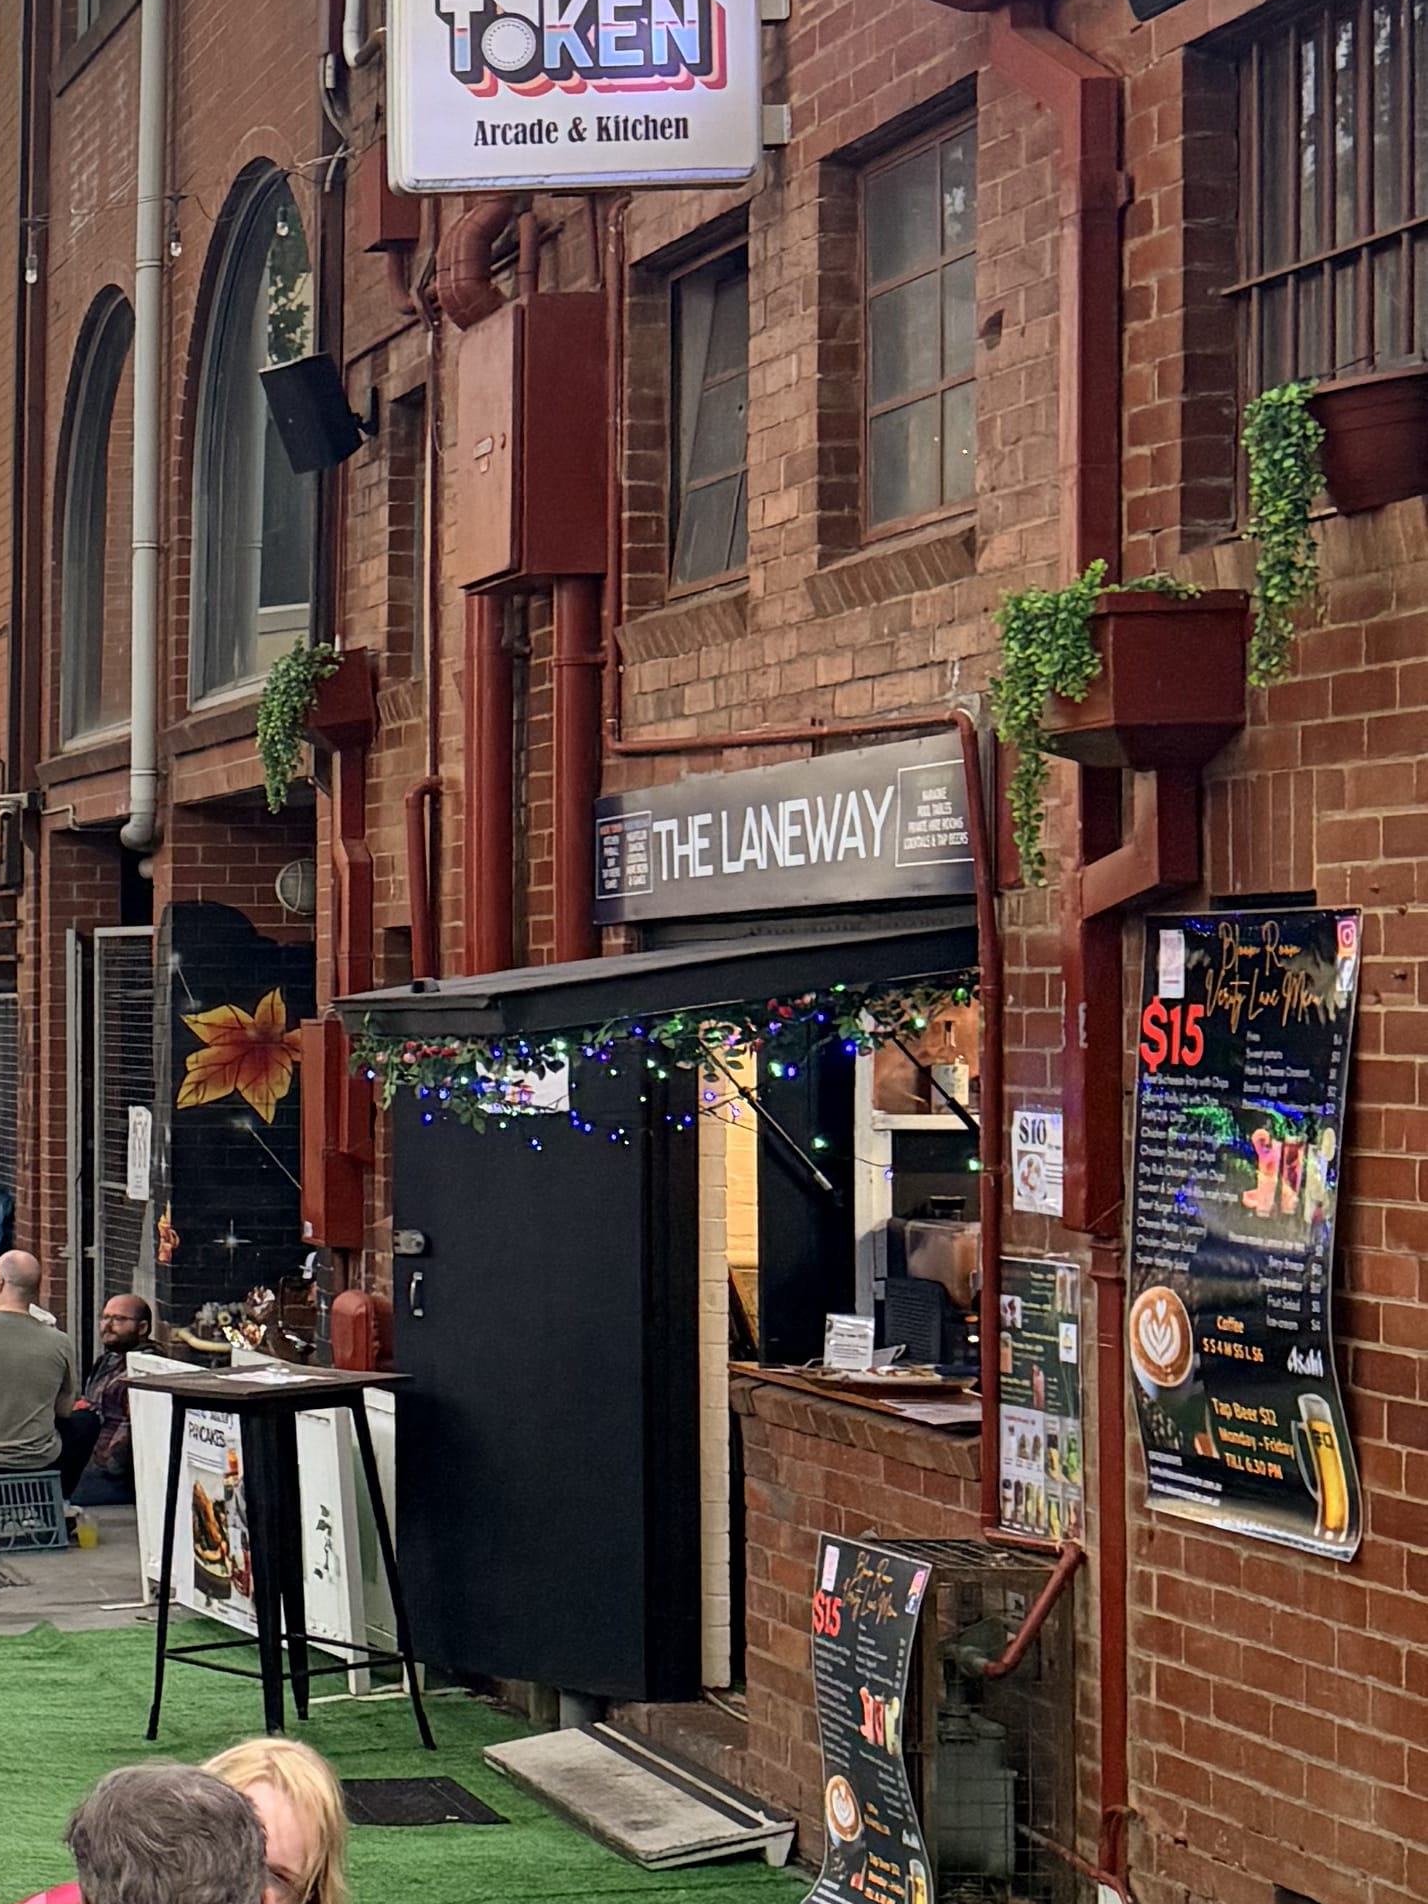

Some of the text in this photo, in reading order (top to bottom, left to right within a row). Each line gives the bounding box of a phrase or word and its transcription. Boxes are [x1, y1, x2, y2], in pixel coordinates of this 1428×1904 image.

[474, 114, 689, 146] Arcade & Kitchen
[653, 785, 895, 881] THE LANEWAY
[1140, 995, 1204, 1074] $15
[1019, 1116, 1047, 1146] $10
[1216, 1315, 1244, 1334] Coffee
[1287, 1345, 1323, 1378] Asahi
[1211, 1397, 1233, 1420] Tap
[1234, 1402, 1258, 1423] Beer
[1218, 1426, 1257, 1452] Monday
[1263, 1435, 1296, 1461] Friday
[1223, 1452, 1245, 1472] TILL
[1267, 1461, 1284, 1481] PM
[813, 1589, 843, 1638] $15
